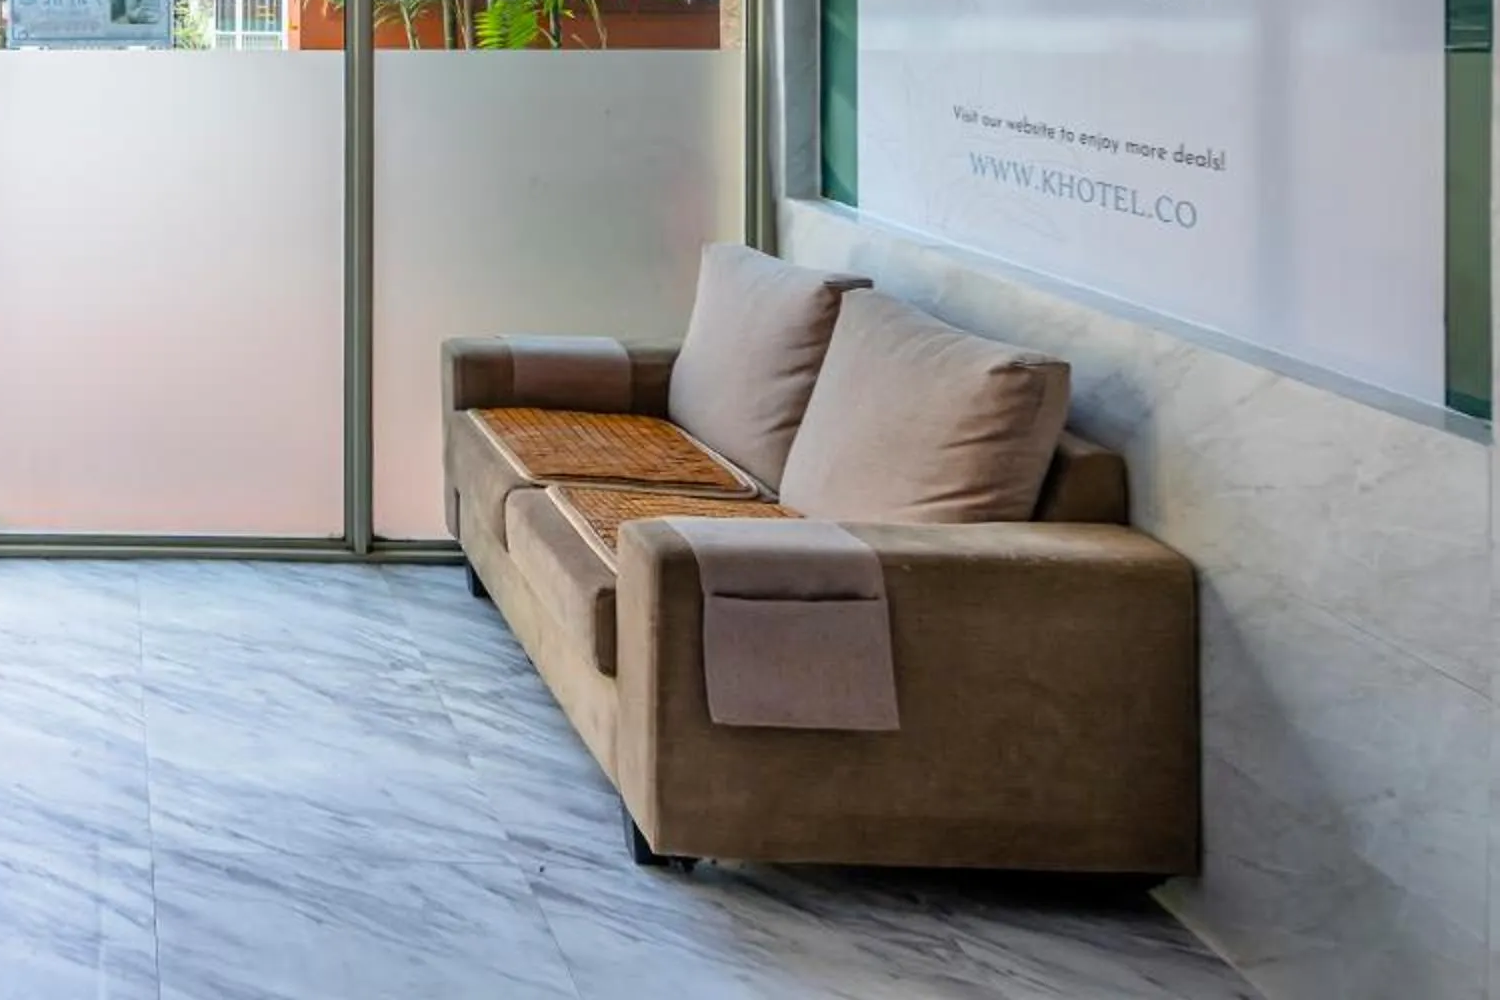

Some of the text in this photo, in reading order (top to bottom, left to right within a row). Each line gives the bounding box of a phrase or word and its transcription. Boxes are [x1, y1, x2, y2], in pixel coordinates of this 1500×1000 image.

[953, 104, 1226, 171] Visit our website to enjoy more deals!
[969, 150, 1198, 228] WWW.KHOTEL.CO
